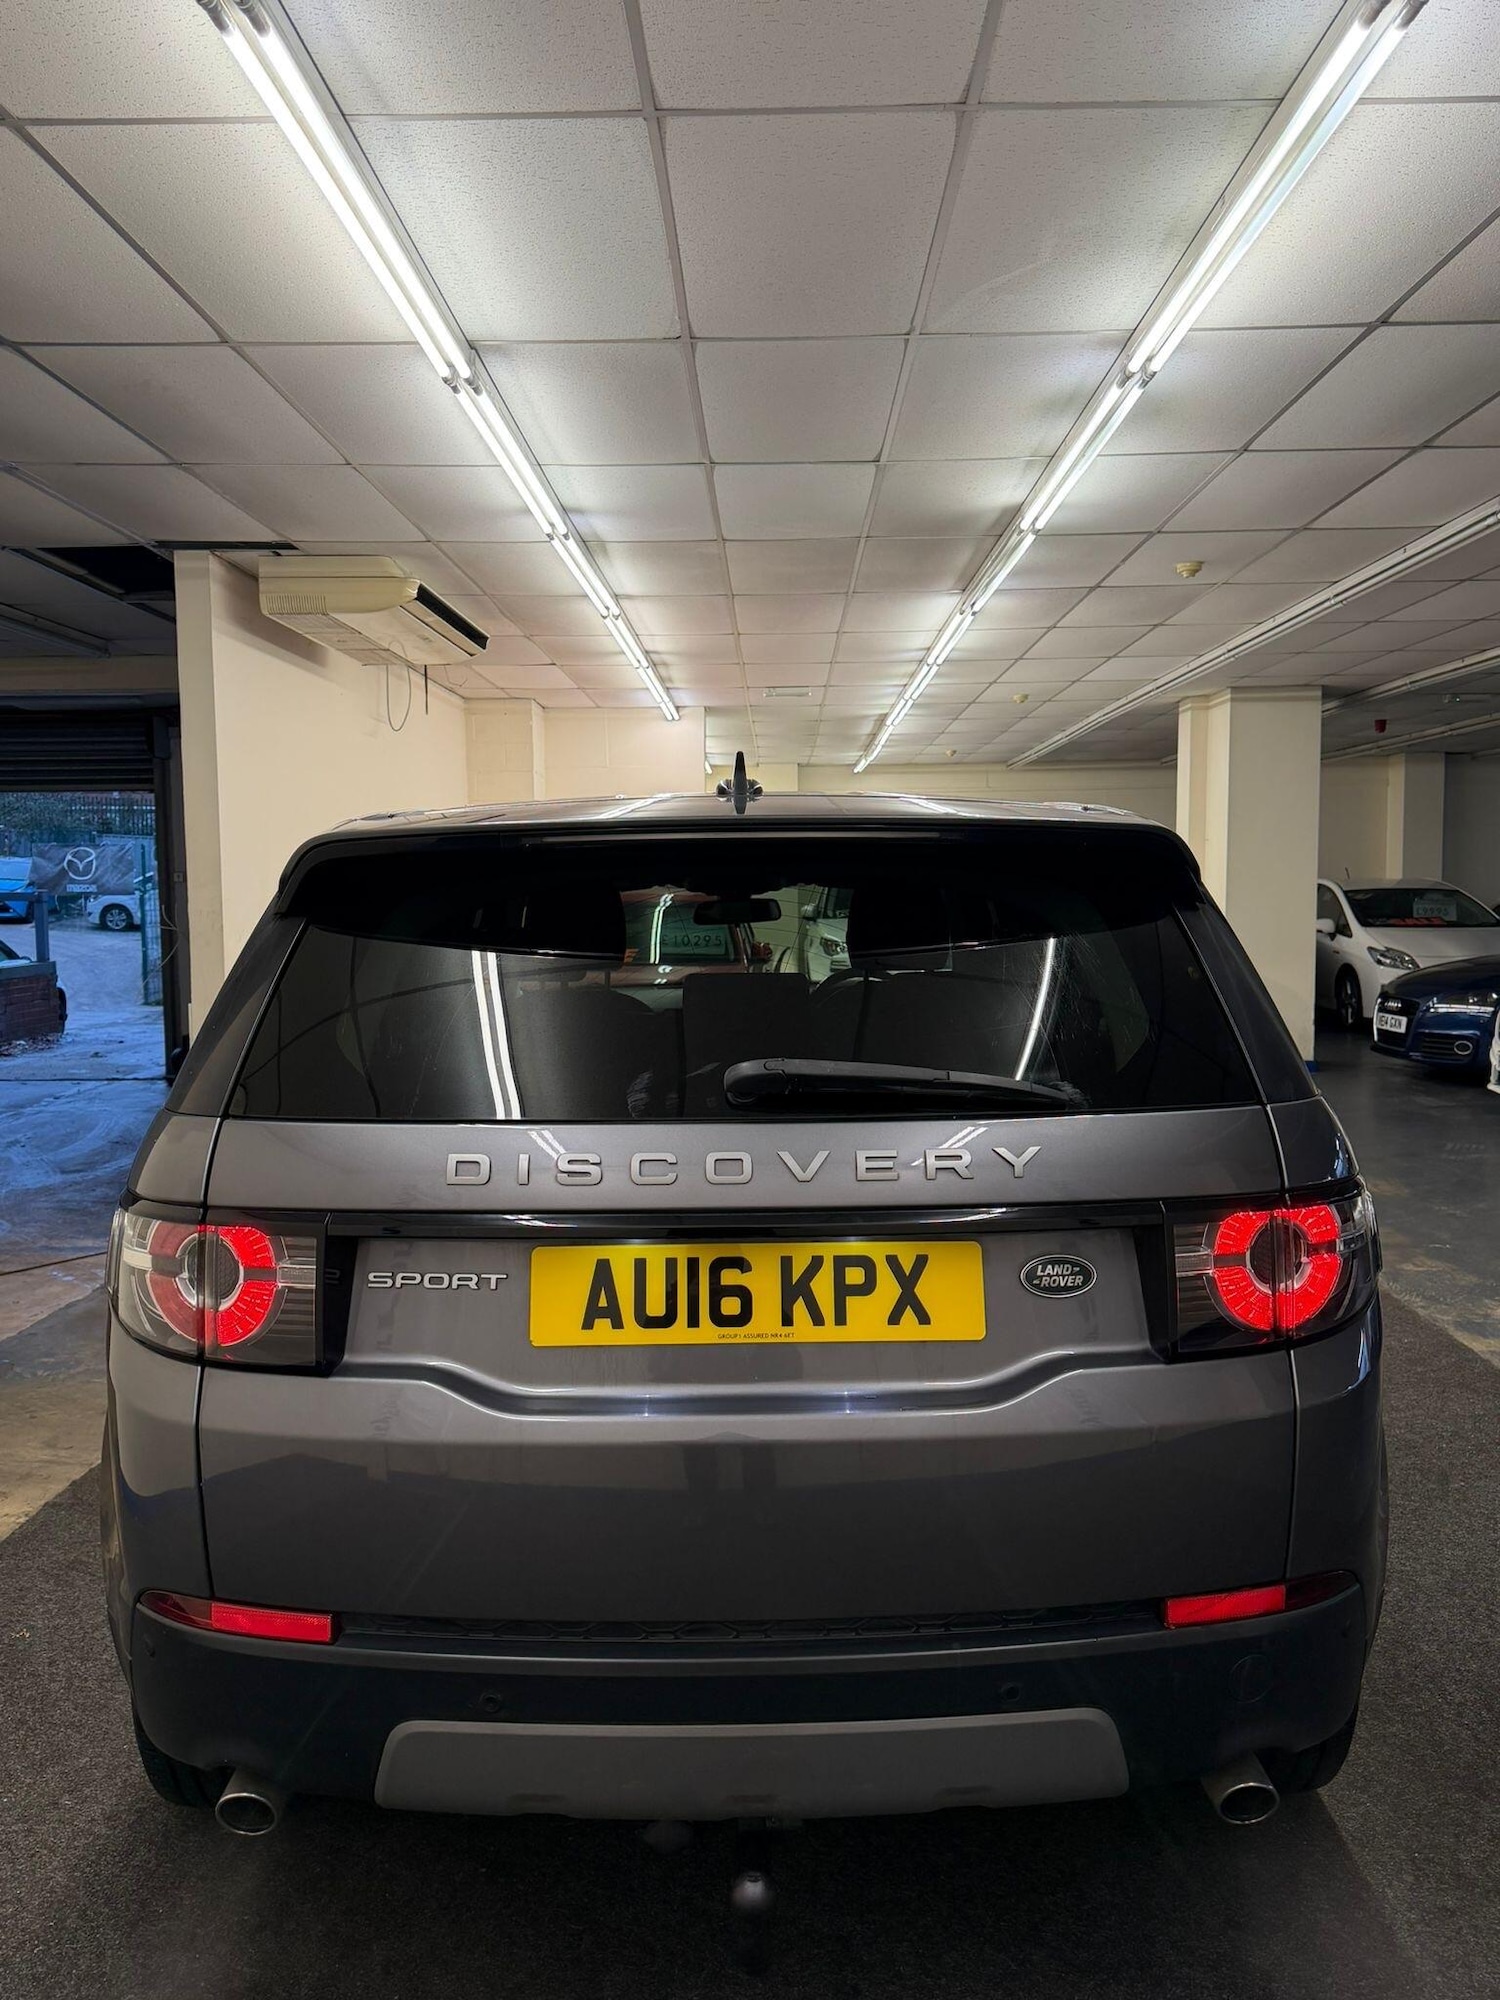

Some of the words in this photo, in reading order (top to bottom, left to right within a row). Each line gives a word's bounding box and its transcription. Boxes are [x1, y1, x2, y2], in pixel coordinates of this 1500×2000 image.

[445, 1145, 1042, 1186] DISCOVERY
[1036, 1263, 1073, 1277] LAND
[367, 1271, 508, 1291] SPORT
[1040, 1275, 1084, 1288] ROVER
[580, 1256, 753, 1331] AU16
[780, 1253, 932, 1327] KPX
